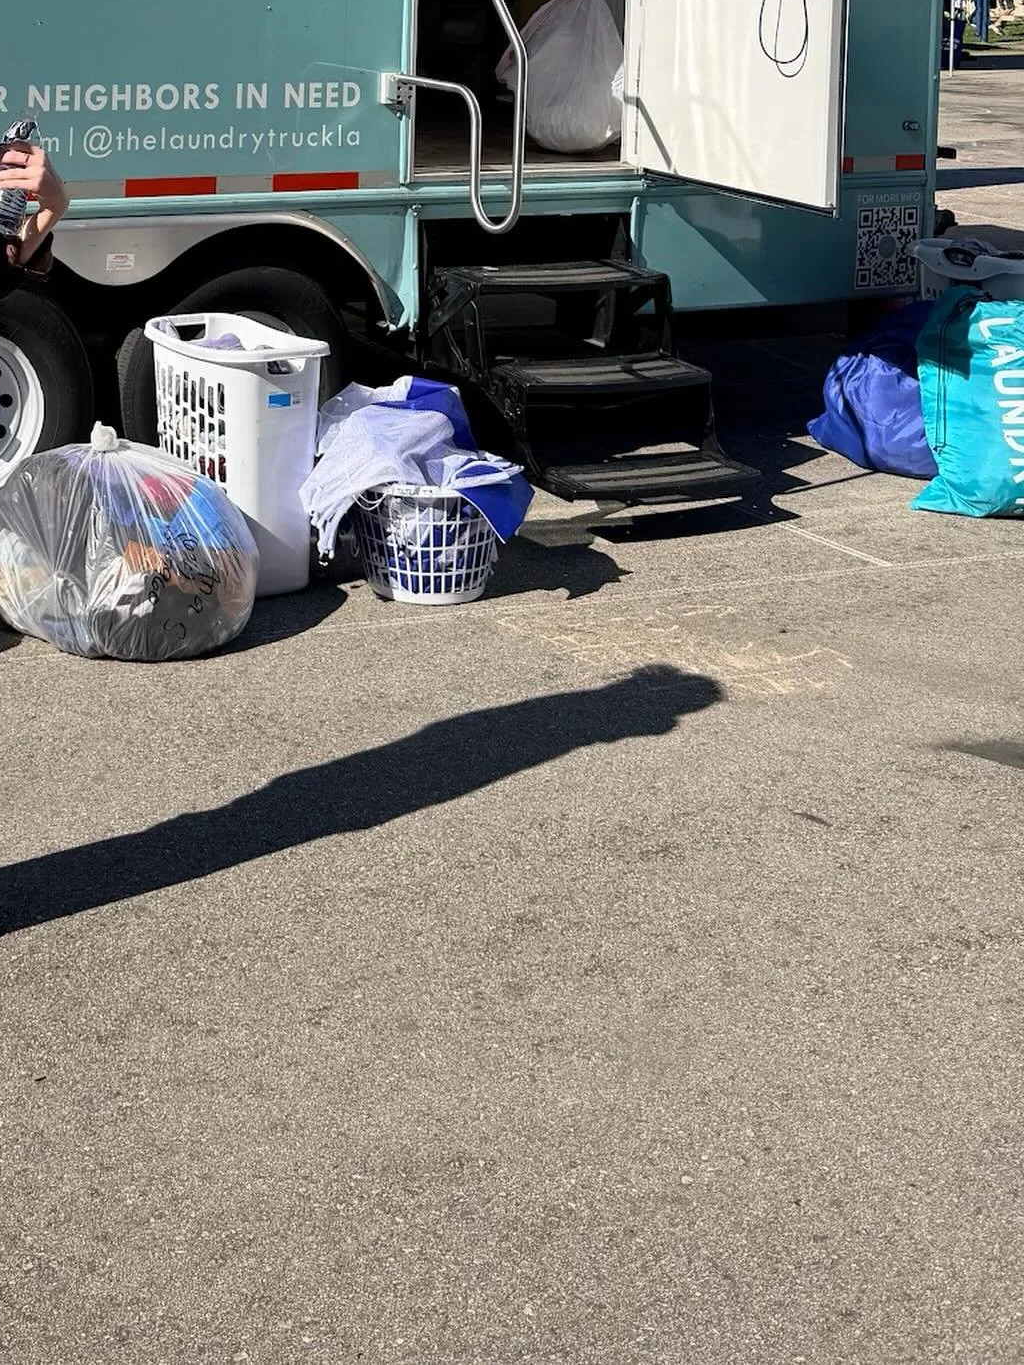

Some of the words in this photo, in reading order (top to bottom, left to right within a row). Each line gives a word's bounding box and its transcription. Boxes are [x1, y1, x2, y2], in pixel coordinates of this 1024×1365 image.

[28, 83, 219, 112] NEIGHBORS
[236, 83, 268, 109] IN
[284, 82, 361, 109] NEED
[83, 124, 360, 158] @thelaundrytruckla
